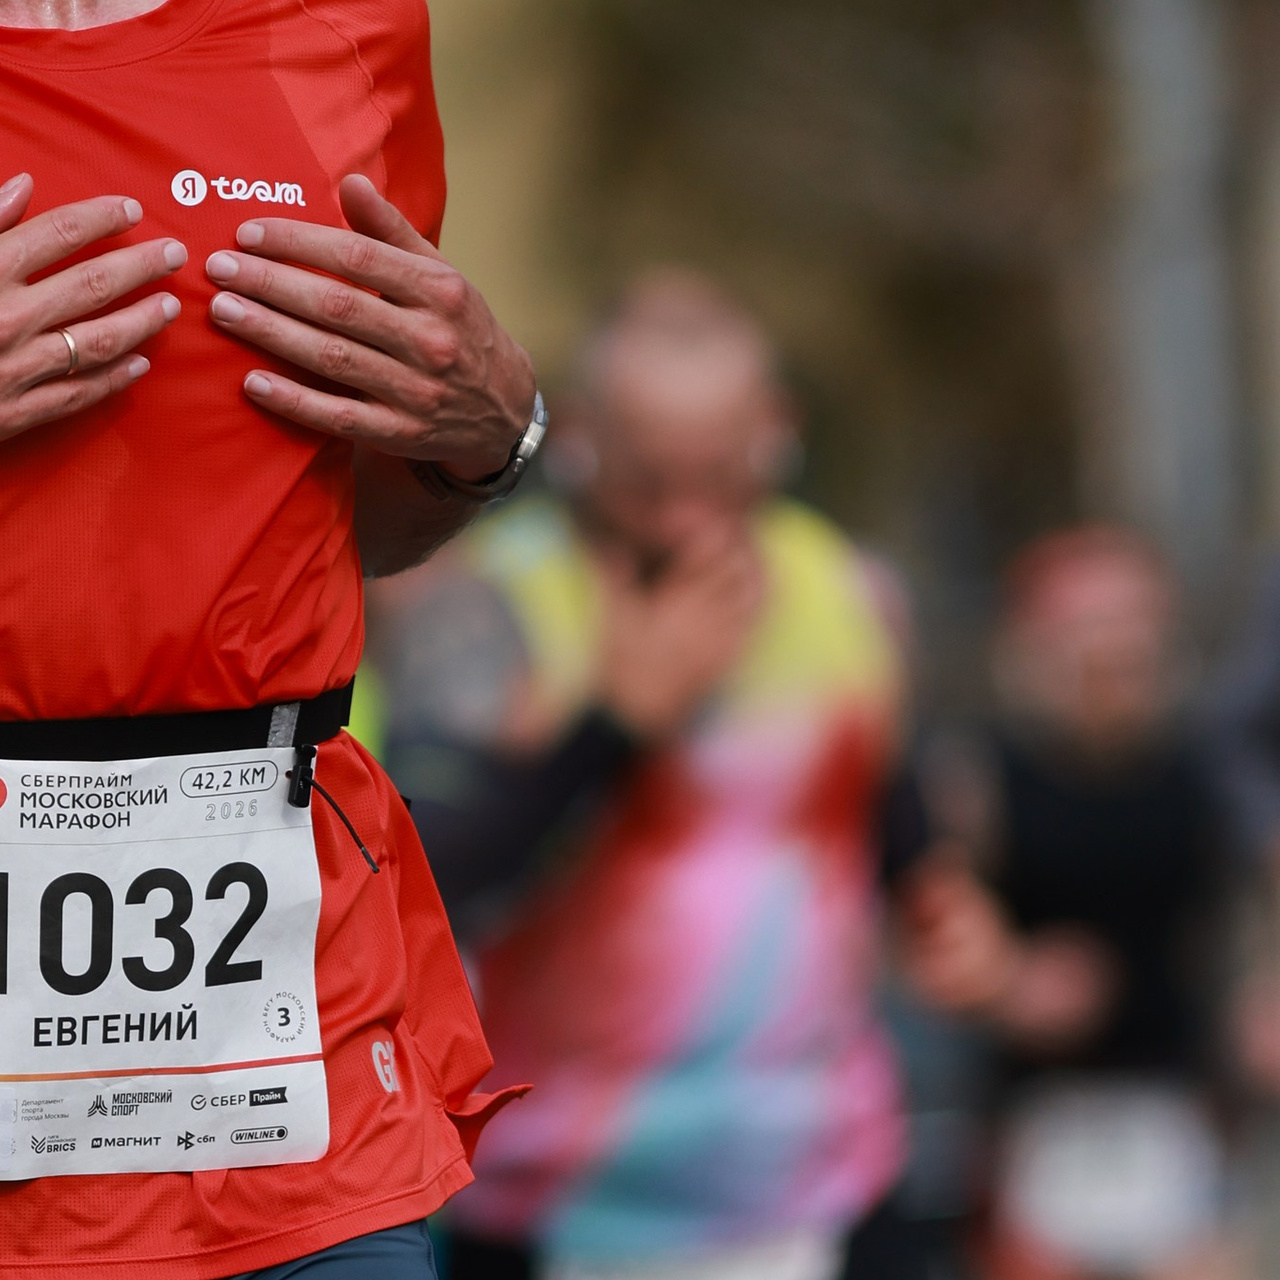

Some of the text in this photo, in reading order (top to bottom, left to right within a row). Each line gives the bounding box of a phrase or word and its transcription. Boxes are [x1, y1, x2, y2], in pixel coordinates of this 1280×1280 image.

[211, 176, 306, 206] team
[20, 772, 132, 788] СБЕРПРАЙМ
[192, 766, 266, 791] 42,2 КМ
[20, 784, 168, 809] МОСКОВСКИЙ
[204, 799, 258, 821] 2026
[20, 811, 131, 829] МАРАФОН
[276, 991, 306, 1035] МОСКОВСКИЙ
[277, 1007, 291, 1027] 3
[33, 1003, 198, 1047] ЕВГЕНИЙ
[262, 1020, 296, 1043] МАРАФОН
[21, 1099, 64, 1107] Департамент
[112, 1089, 173, 1104] МОСКОВСКИЙ
[211, 1092, 282, 1107] СБЕР Прайм
[111, 1105, 140, 1116] СПОРТ
[197, 1136, 216, 1144] сбп
[235, 1130, 276, 1141] WINLINE
[46, 1143, 76, 1154] BRICS
